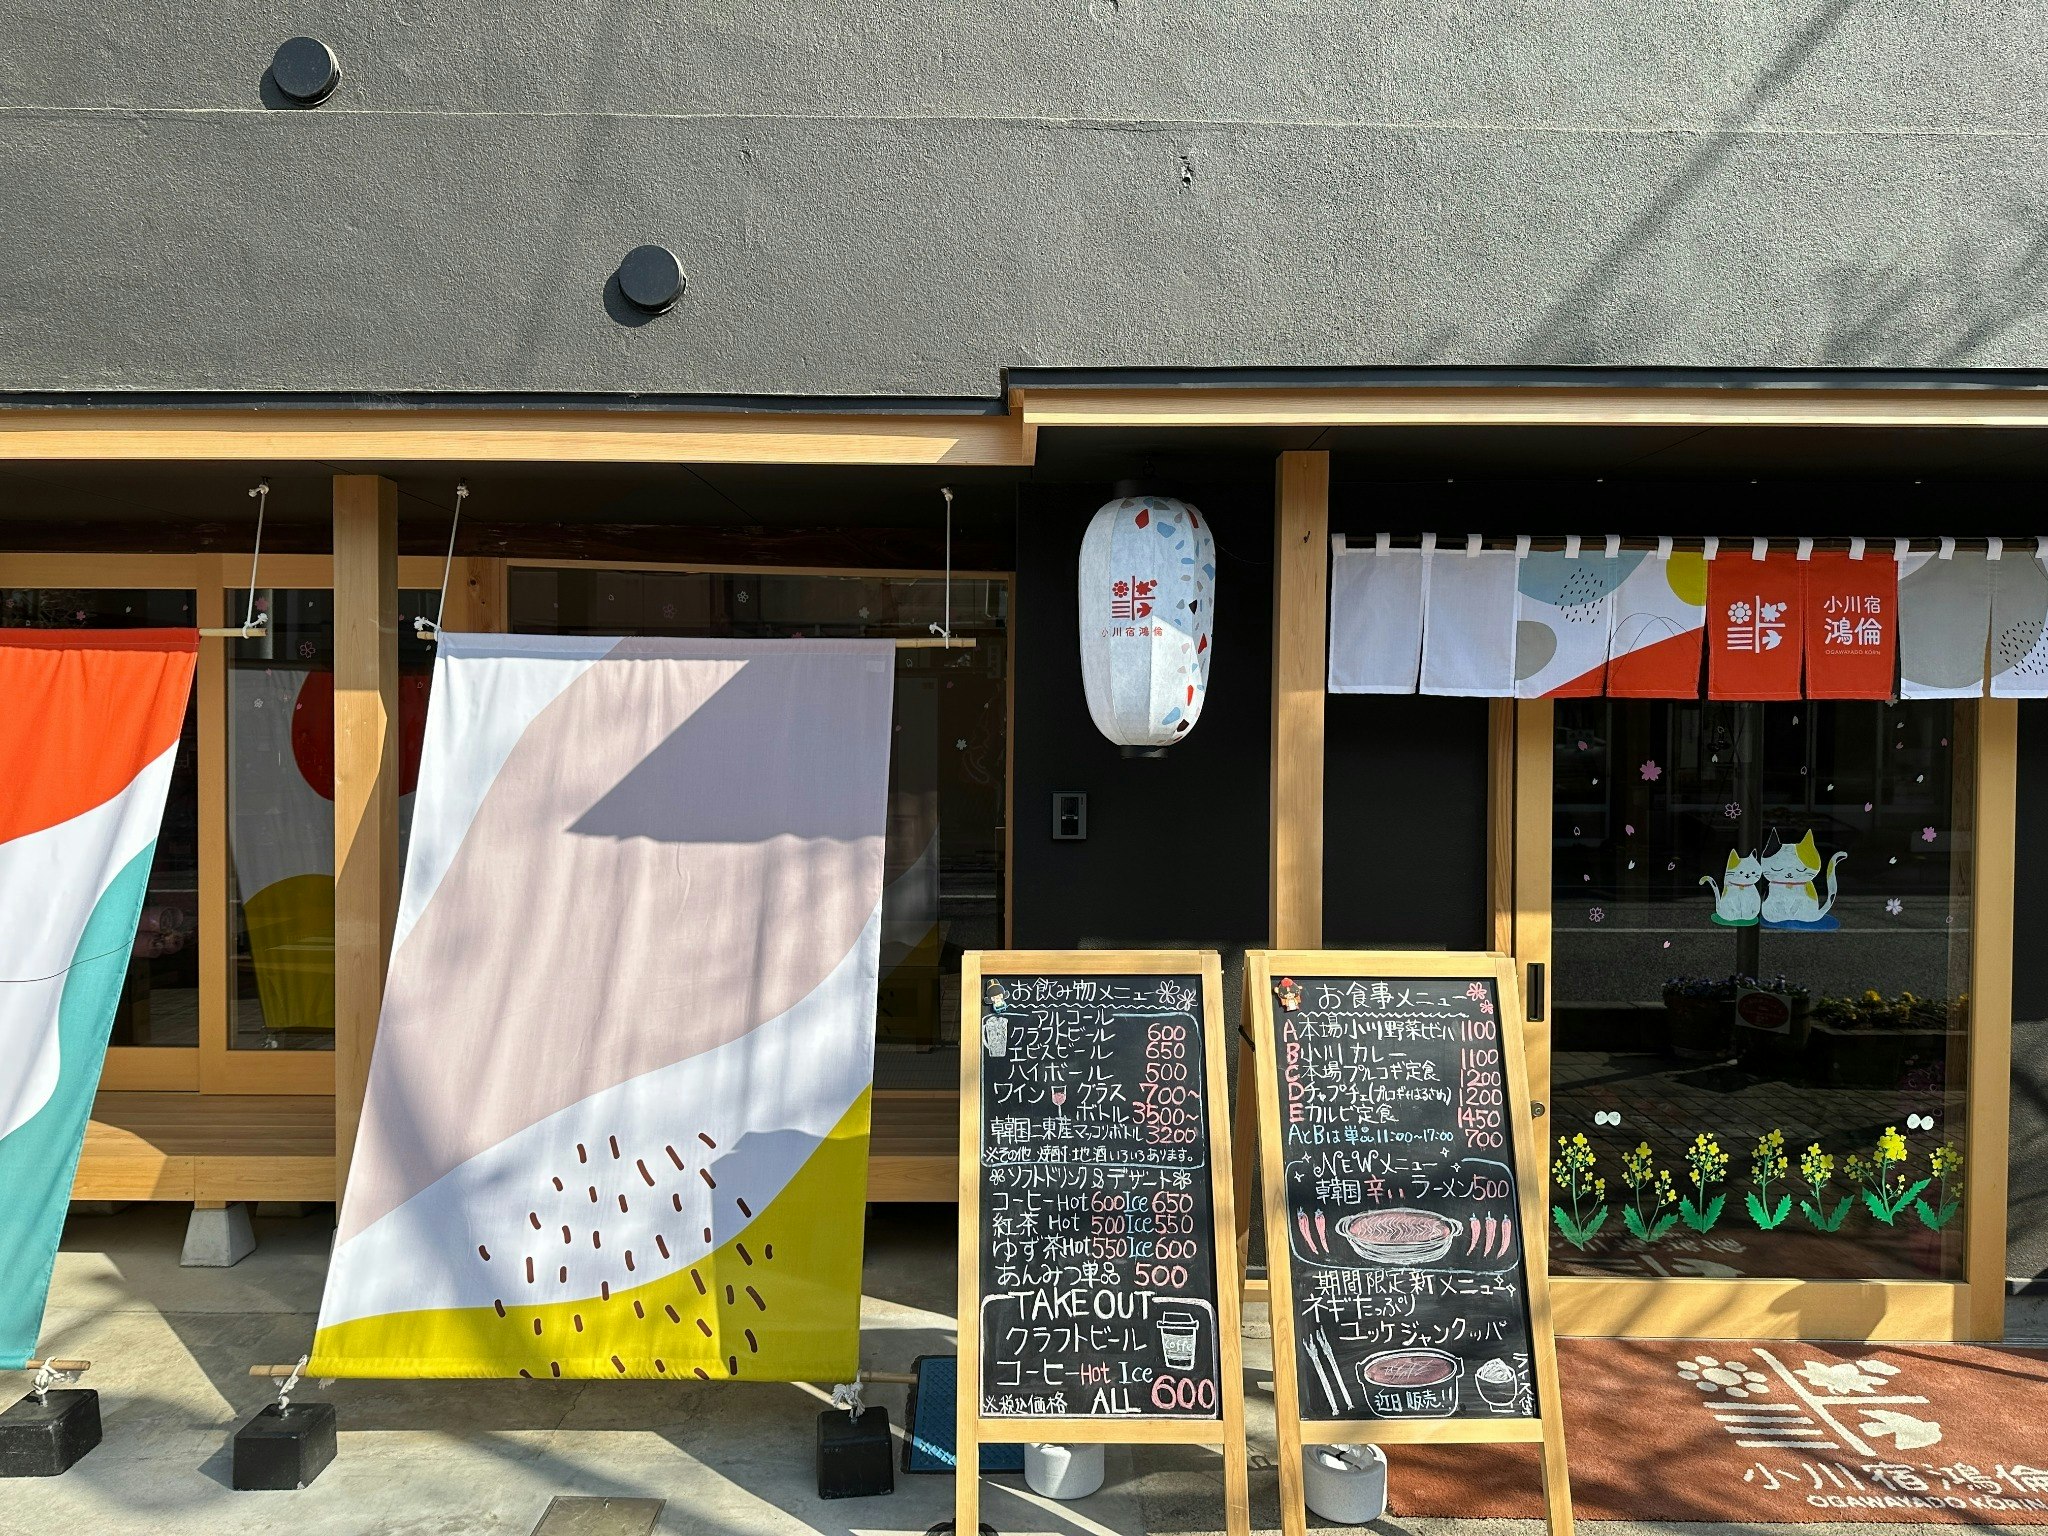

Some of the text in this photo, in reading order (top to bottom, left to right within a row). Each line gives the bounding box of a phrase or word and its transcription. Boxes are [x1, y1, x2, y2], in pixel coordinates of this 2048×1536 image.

[1823, 595, 1881, 614] 小川宿
[1101, 626, 1163, 638] 小川宿鴻倫
[1824, 617, 1882, 646] 鴻倫
[1011, 977, 1156, 1001] お飲み物メニュー
[1315, 980, 1467, 1010] お食事メニュー
[1031, 1010, 1115, 1028] アルコール
[1283, 1019, 1298, 1042] A
[1461, 1020, 1497, 1042] 1100
[1010, 1023, 1186, 1046] クラフトビール 600
[1008, 1042, 1185, 1062] エビスビール 650
[1286, 1043, 1300, 1064] B
[1461, 1047, 1499, 1069] 1100
[1008, 1062, 1188, 1082] ハイボール 500
[1285, 1065, 1300, 1083] C
[1459, 1070, 1501, 1088] 1200
[993, 1083, 1045, 1104] ワイン
[1077, 1083, 1127, 1104] グラス
[1288, 1083, 1304, 1101] D
[1459, 1088, 1503, 1106] 1200
[1076, 1104, 1129, 1123] ボトル
[1288, 1104, 1501, 1128] E カルビ定食 1450
[1145, 1125, 1197, 1145] 3200
[1465, 1129, 1503, 1149] 700
[1472, 1173, 1510, 1200] 500
[992, 1190, 1193, 1213] コーヒー Hot 600 Ice 650
[992, 1212, 1194, 1237] 紅茶 Hot 500 Ice 550
[992, 1233, 1197, 1262] ゆず茶 Hot 550 Ice 600
[995, 1260, 1188, 1288] あんみつ単品 500
[1014, 1288, 1156, 1321] TAKE OUT
[1301, 1293, 1416, 1323] ネギたっぷり
[1006, 1323, 1147, 1355] クラフトビール
[996, 1359, 1154, 1386] コーヒー Hot Ice
[1091, 1387, 1142, 1414] ALL
[1151, 1374, 1216, 1410] 600
[1806, 1493, 1967, 1509] OGAWAYADO
